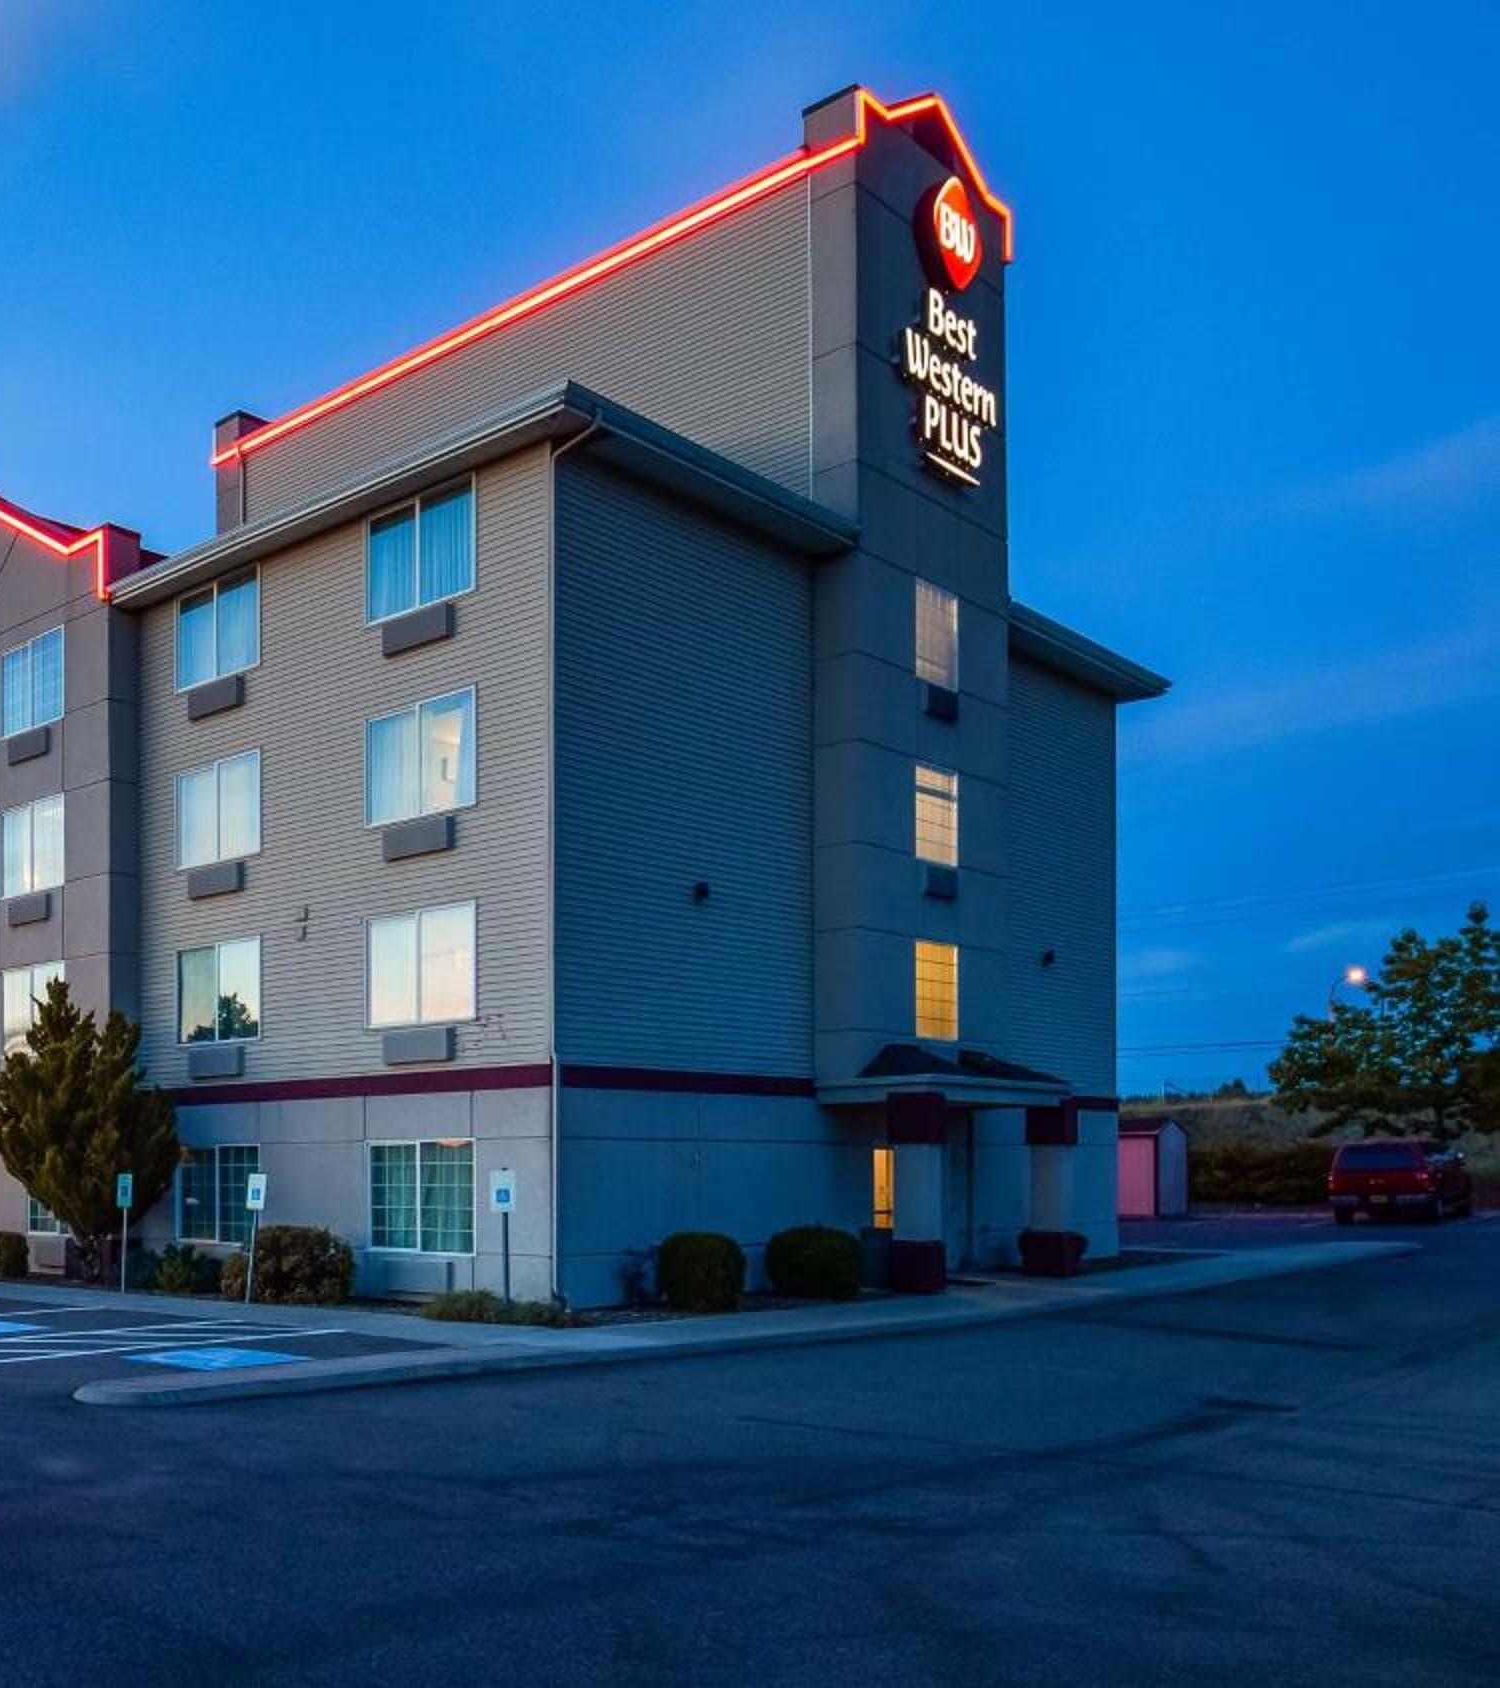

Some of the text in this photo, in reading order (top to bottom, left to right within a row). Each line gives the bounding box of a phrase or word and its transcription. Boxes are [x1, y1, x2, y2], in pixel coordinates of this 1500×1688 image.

[939, 203, 975, 264] BW
[927, 287, 977, 361] Best
[905, 327, 997, 427] Western
[923, 393, 983, 469] PLUS
